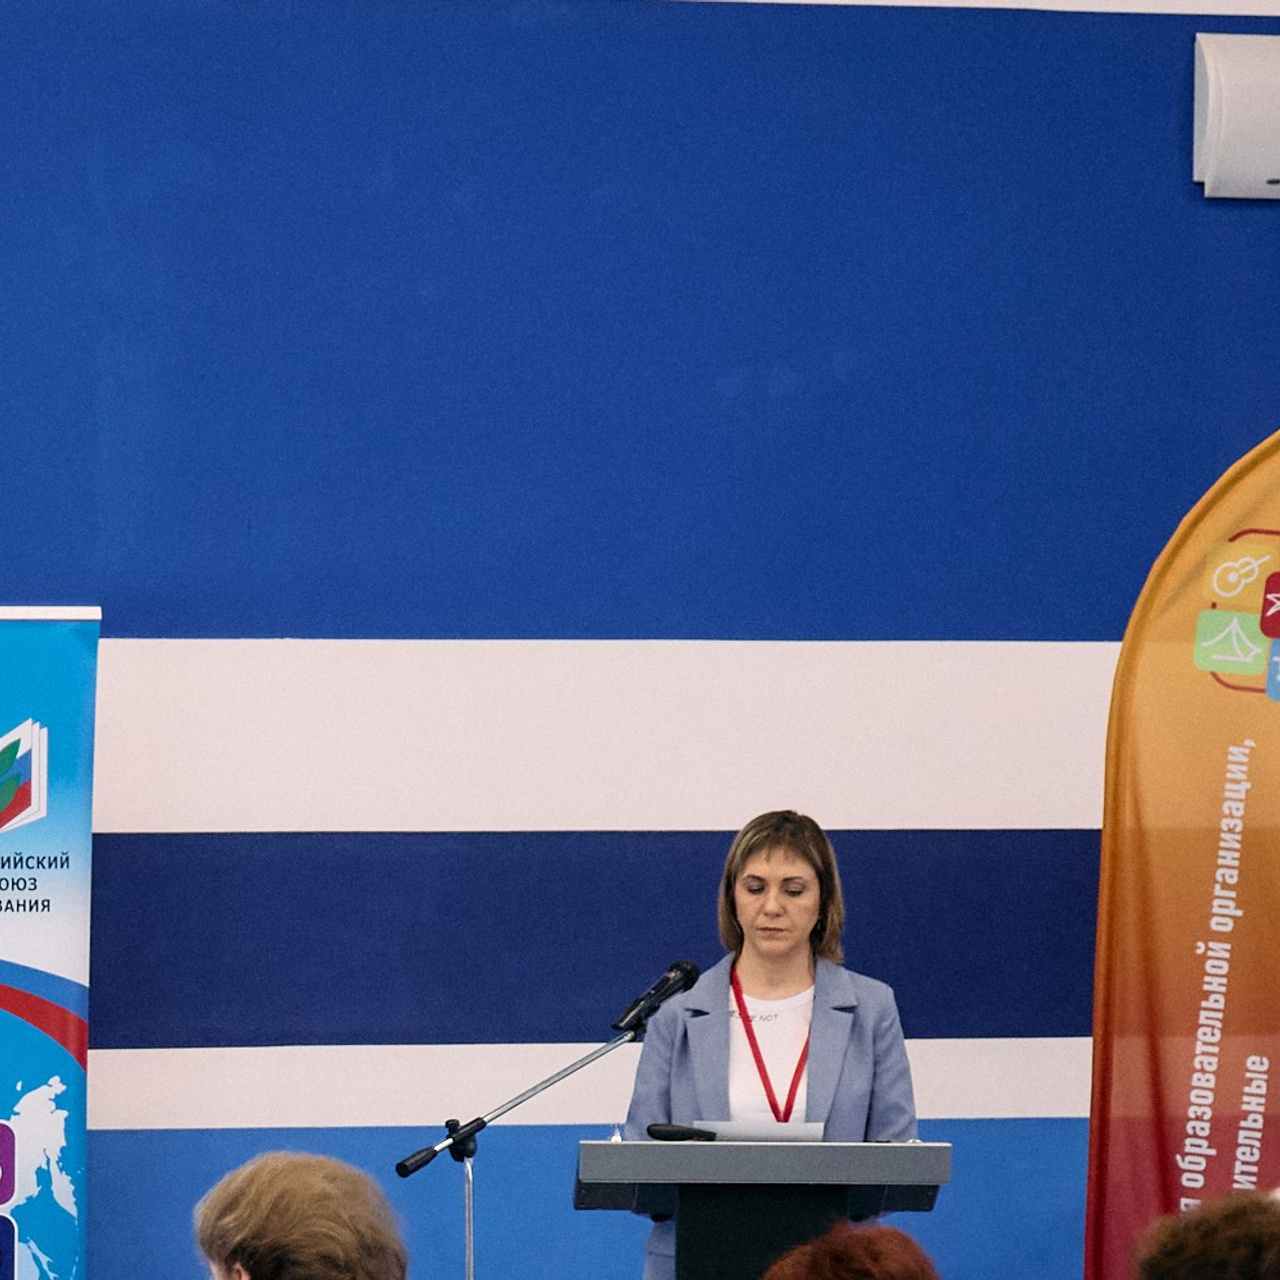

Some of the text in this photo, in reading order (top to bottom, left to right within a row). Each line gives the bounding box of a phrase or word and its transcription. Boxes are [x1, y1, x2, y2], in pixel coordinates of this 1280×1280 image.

[1176, 940, 1232, 1189] образовательной
[1209, 738, 1256, 933] организации,
[1232, 1054, 1269, 1190] ительные
